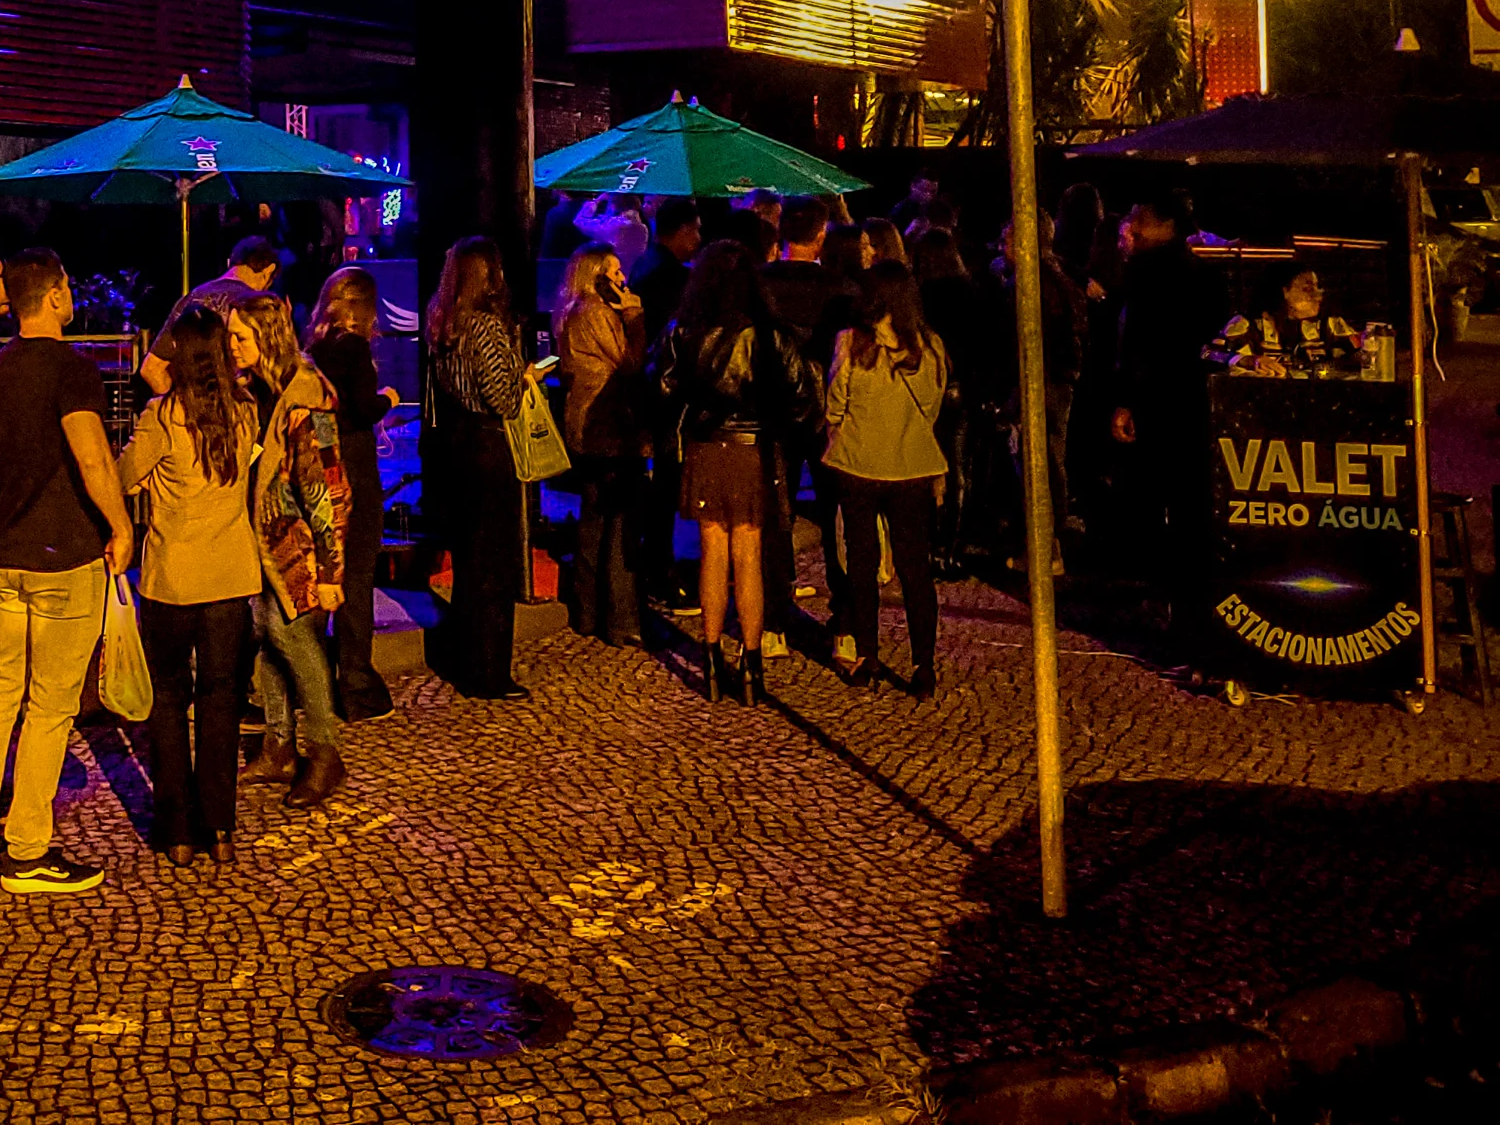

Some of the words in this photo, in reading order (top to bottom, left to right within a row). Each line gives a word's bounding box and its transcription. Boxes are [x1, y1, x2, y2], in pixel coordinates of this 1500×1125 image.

[1218, 438, 1407, 497] VALET
[1228, 500, 1310, 526] ZERO
[1317, 499, 1404, 531] ÁGUA
[1215, 593, 1421, 666] ESTACIONAMENTOS
